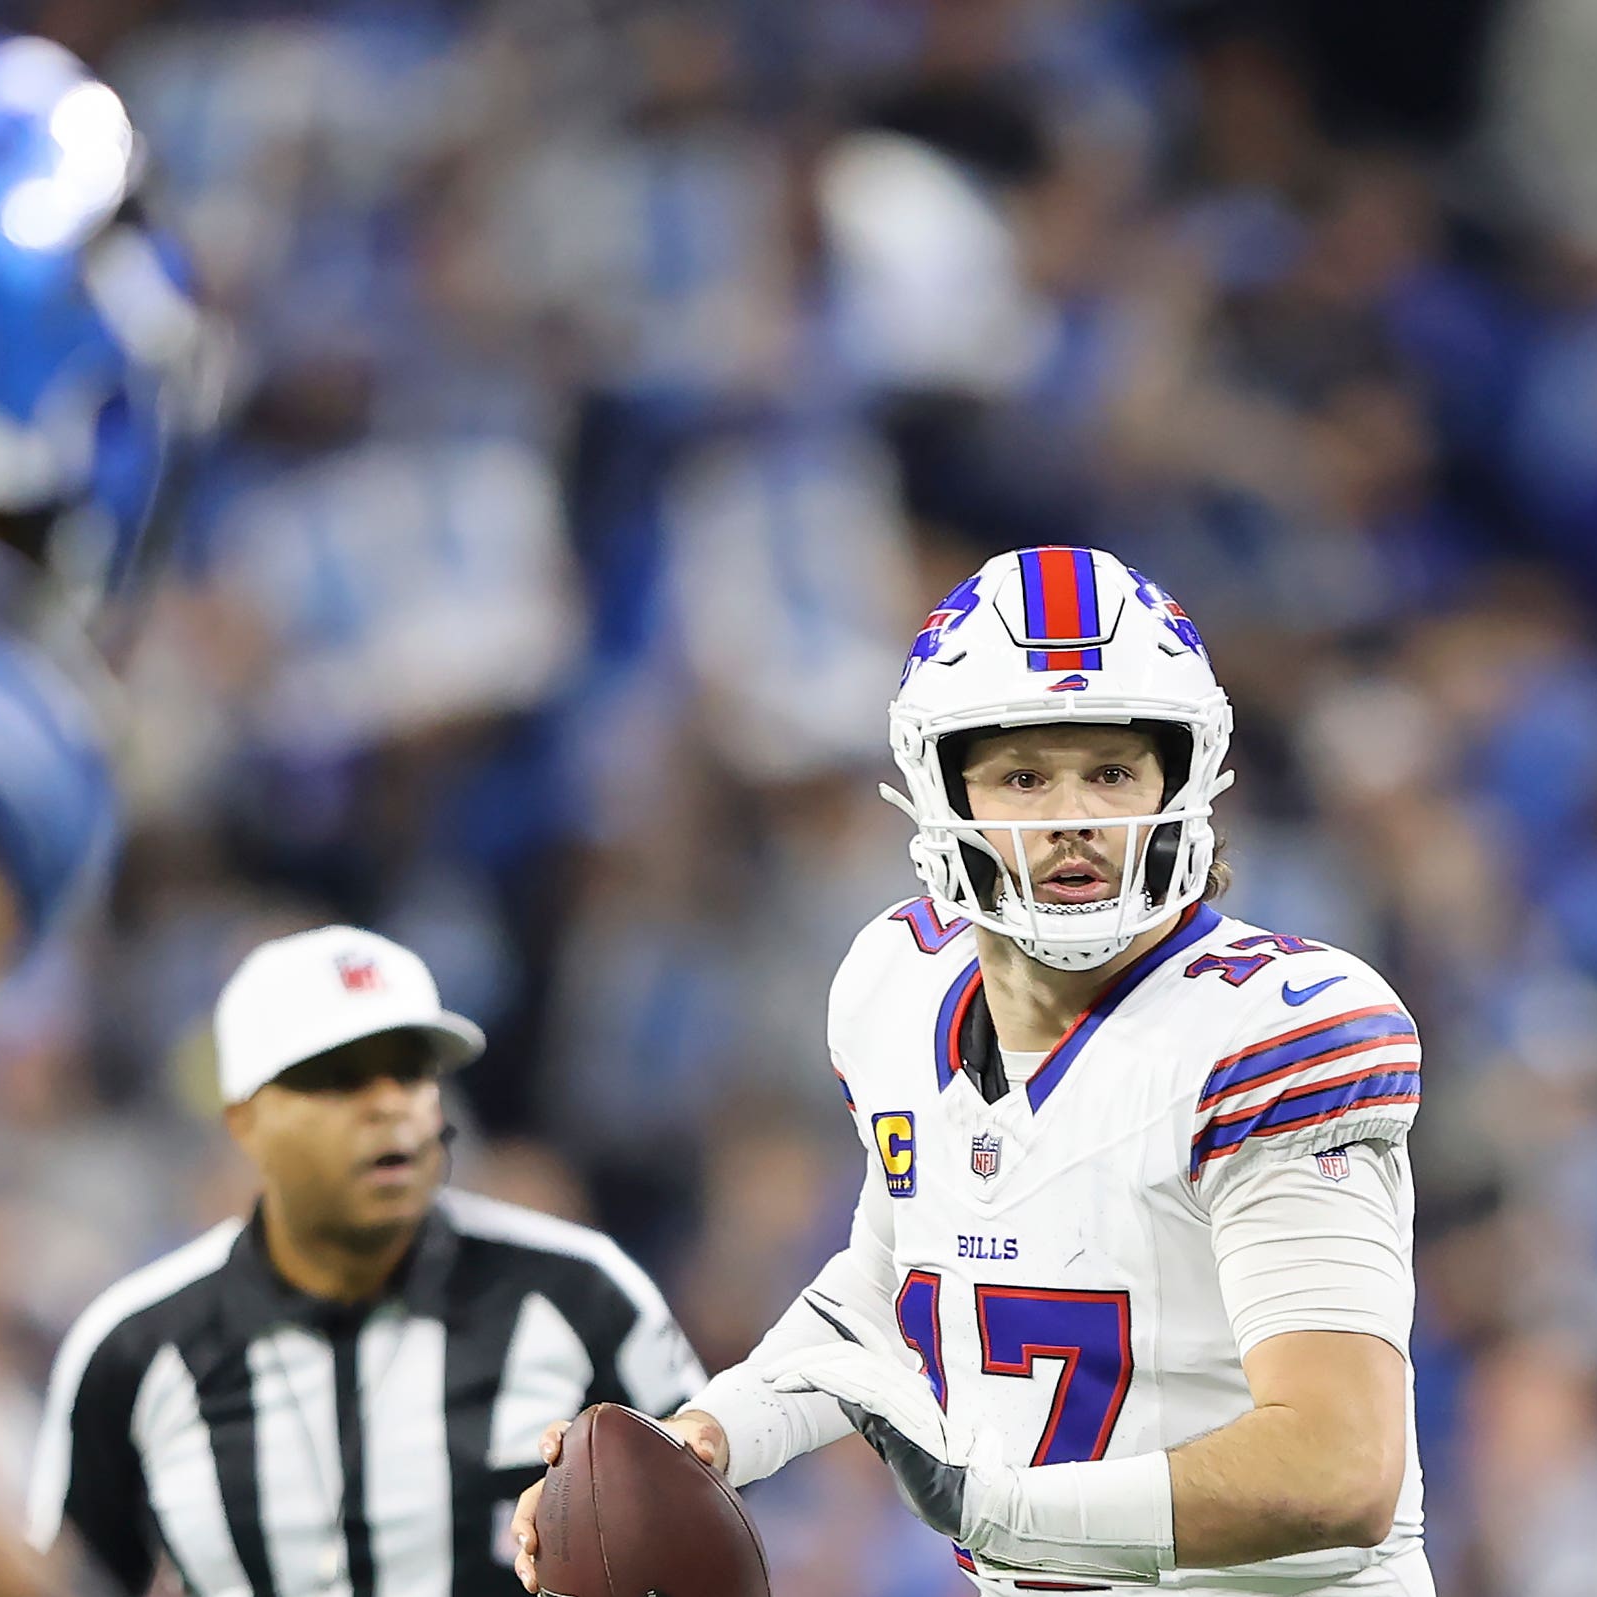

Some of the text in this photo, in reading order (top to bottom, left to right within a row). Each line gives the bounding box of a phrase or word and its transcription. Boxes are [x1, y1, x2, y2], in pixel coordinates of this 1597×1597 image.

[875, 1116, 912, 1175] C
[975, 1152, 996, 1174] NFL
[1320, 1157, 1348, 1177] NFL
[957, 1234, 1019, 1260] BILLS
[896, 1268, 1135, 1590] 17
